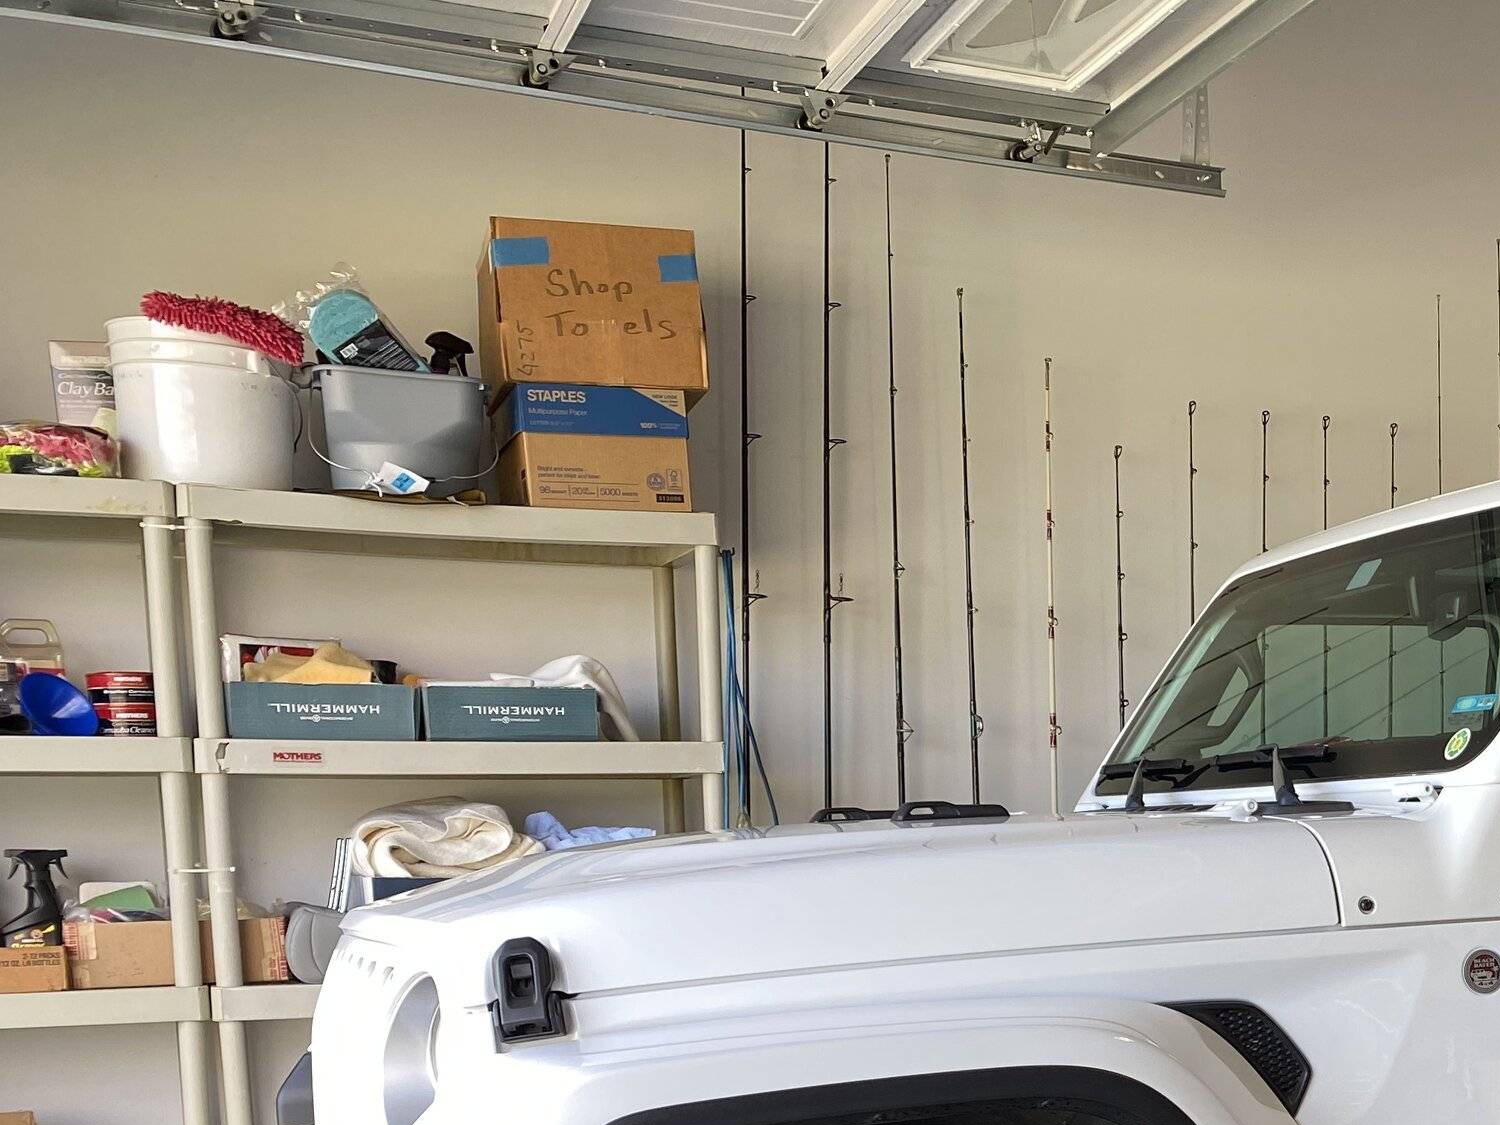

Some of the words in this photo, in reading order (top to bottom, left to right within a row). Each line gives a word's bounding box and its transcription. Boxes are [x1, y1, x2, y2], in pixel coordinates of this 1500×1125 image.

[545, 268, 633, 302] Shop
[543, 309, 676, 340] Toels
[57, 382, 90, 397] Clay
[94, 382, 114, 396] Ba
[527, 389, 586, 404] STAPLES
[600, 488, 621, 497] 5000
[268, 703, 381, 715] HAMMERMILL
[460, 705, 565, 716] HAMMERMILL
[273, 752, 322, 762] MOTHERS
